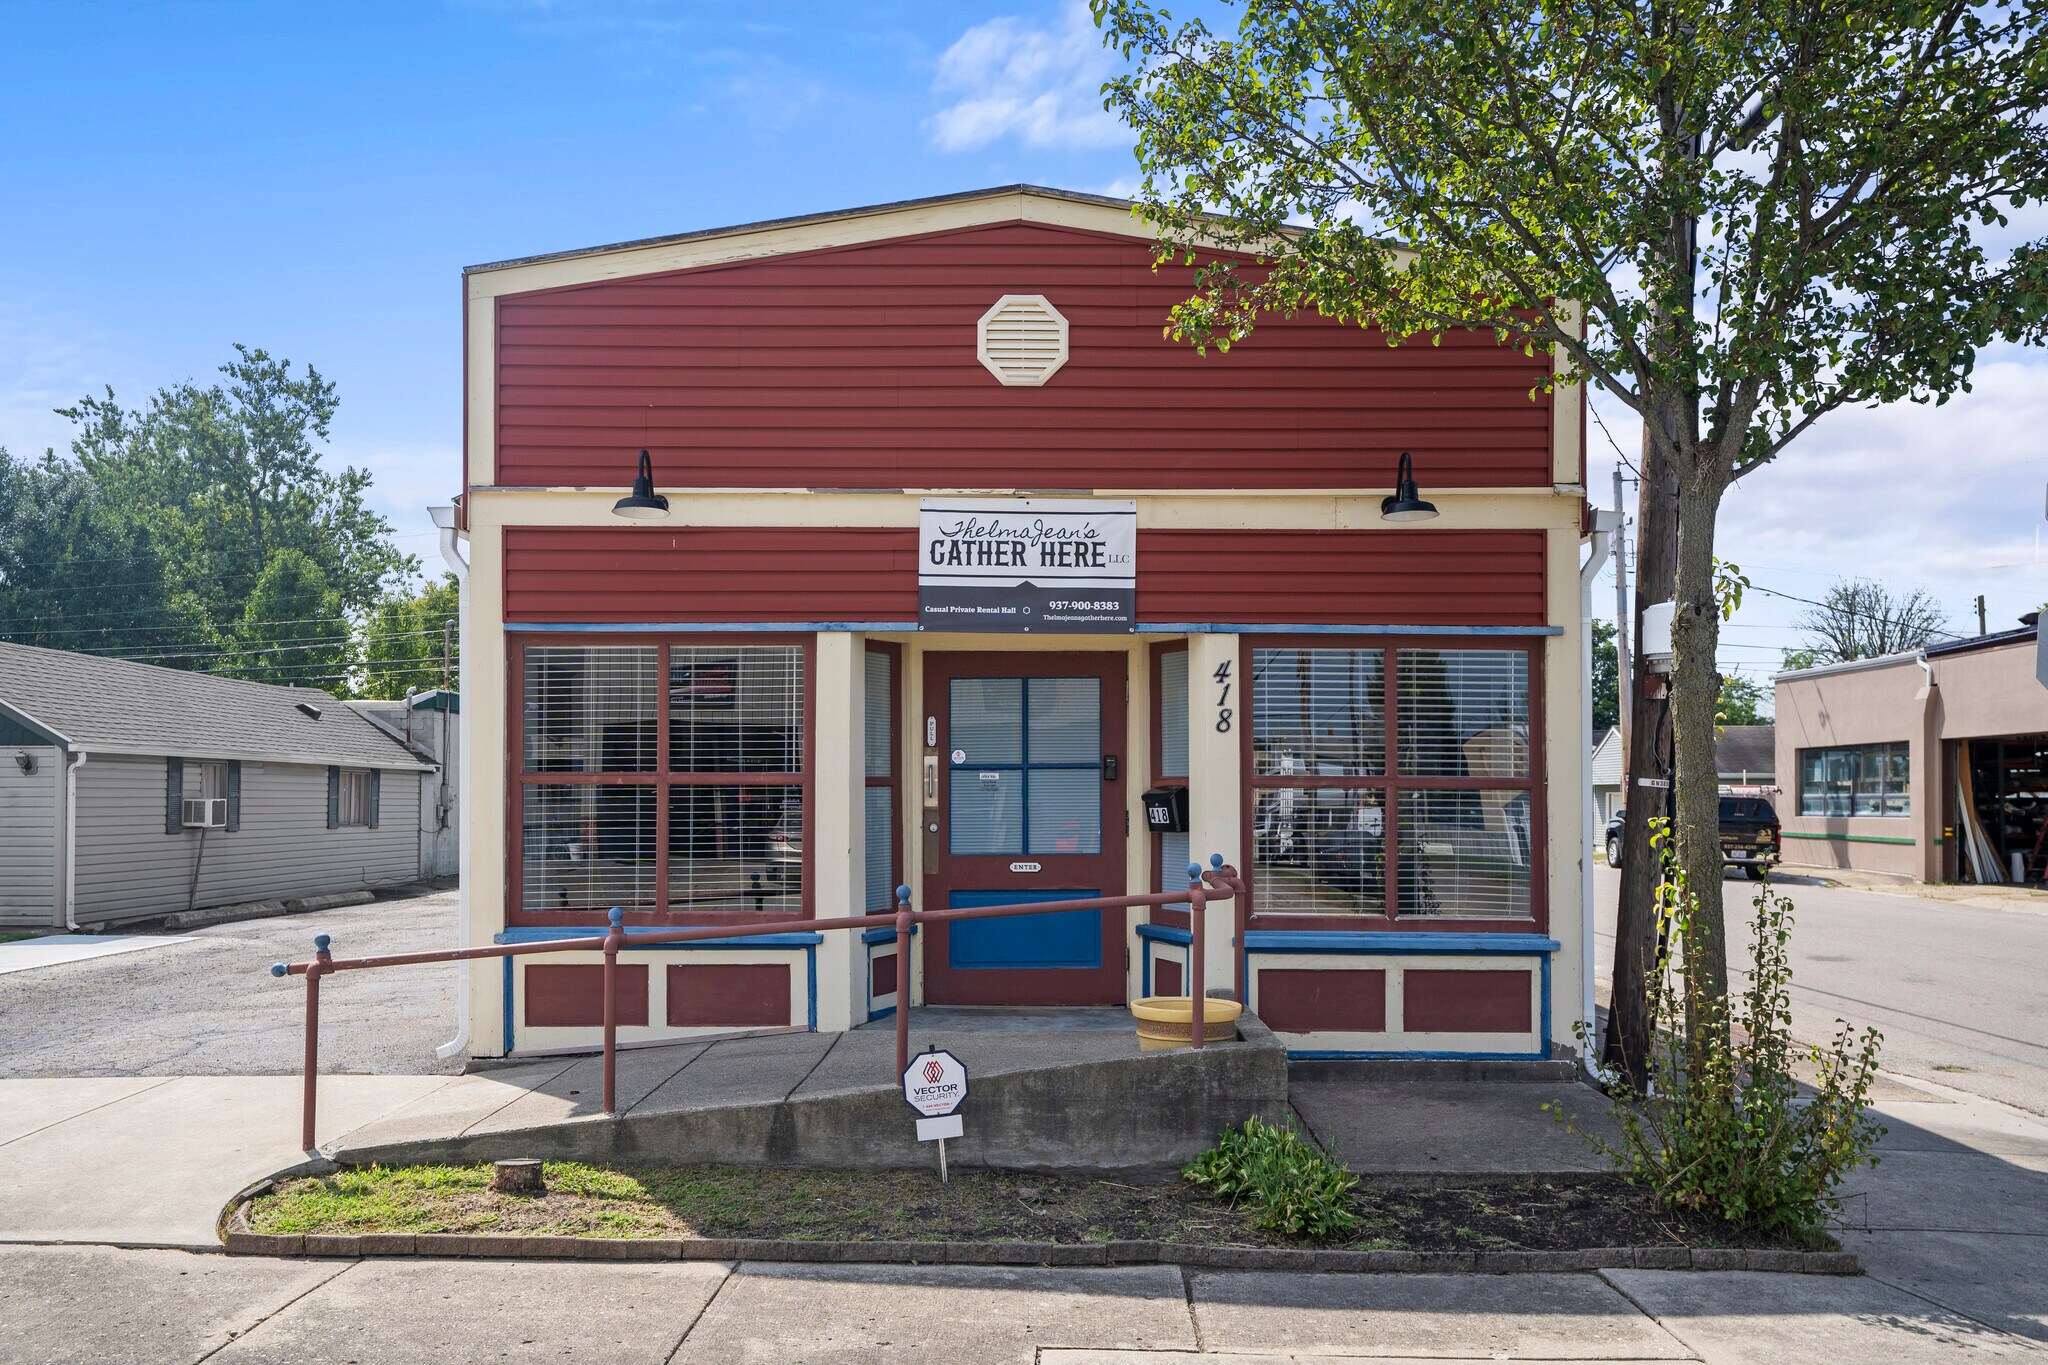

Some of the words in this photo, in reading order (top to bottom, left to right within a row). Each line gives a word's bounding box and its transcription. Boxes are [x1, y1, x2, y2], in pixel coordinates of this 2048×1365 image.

[929, 539, 1028, 567] GATHER
[1040, 541, 1107, 568] HERE
[1108, 554, 1130, 564] LLC
[925, 605, 949, 613] Casual
[977, 606, 1000, 614] Rental
[1049, 601, 1119, 611] 937-900-8383
[1151, 808, 1168, 822] 418
[914, 1084, 957, 1095] VECTOR
